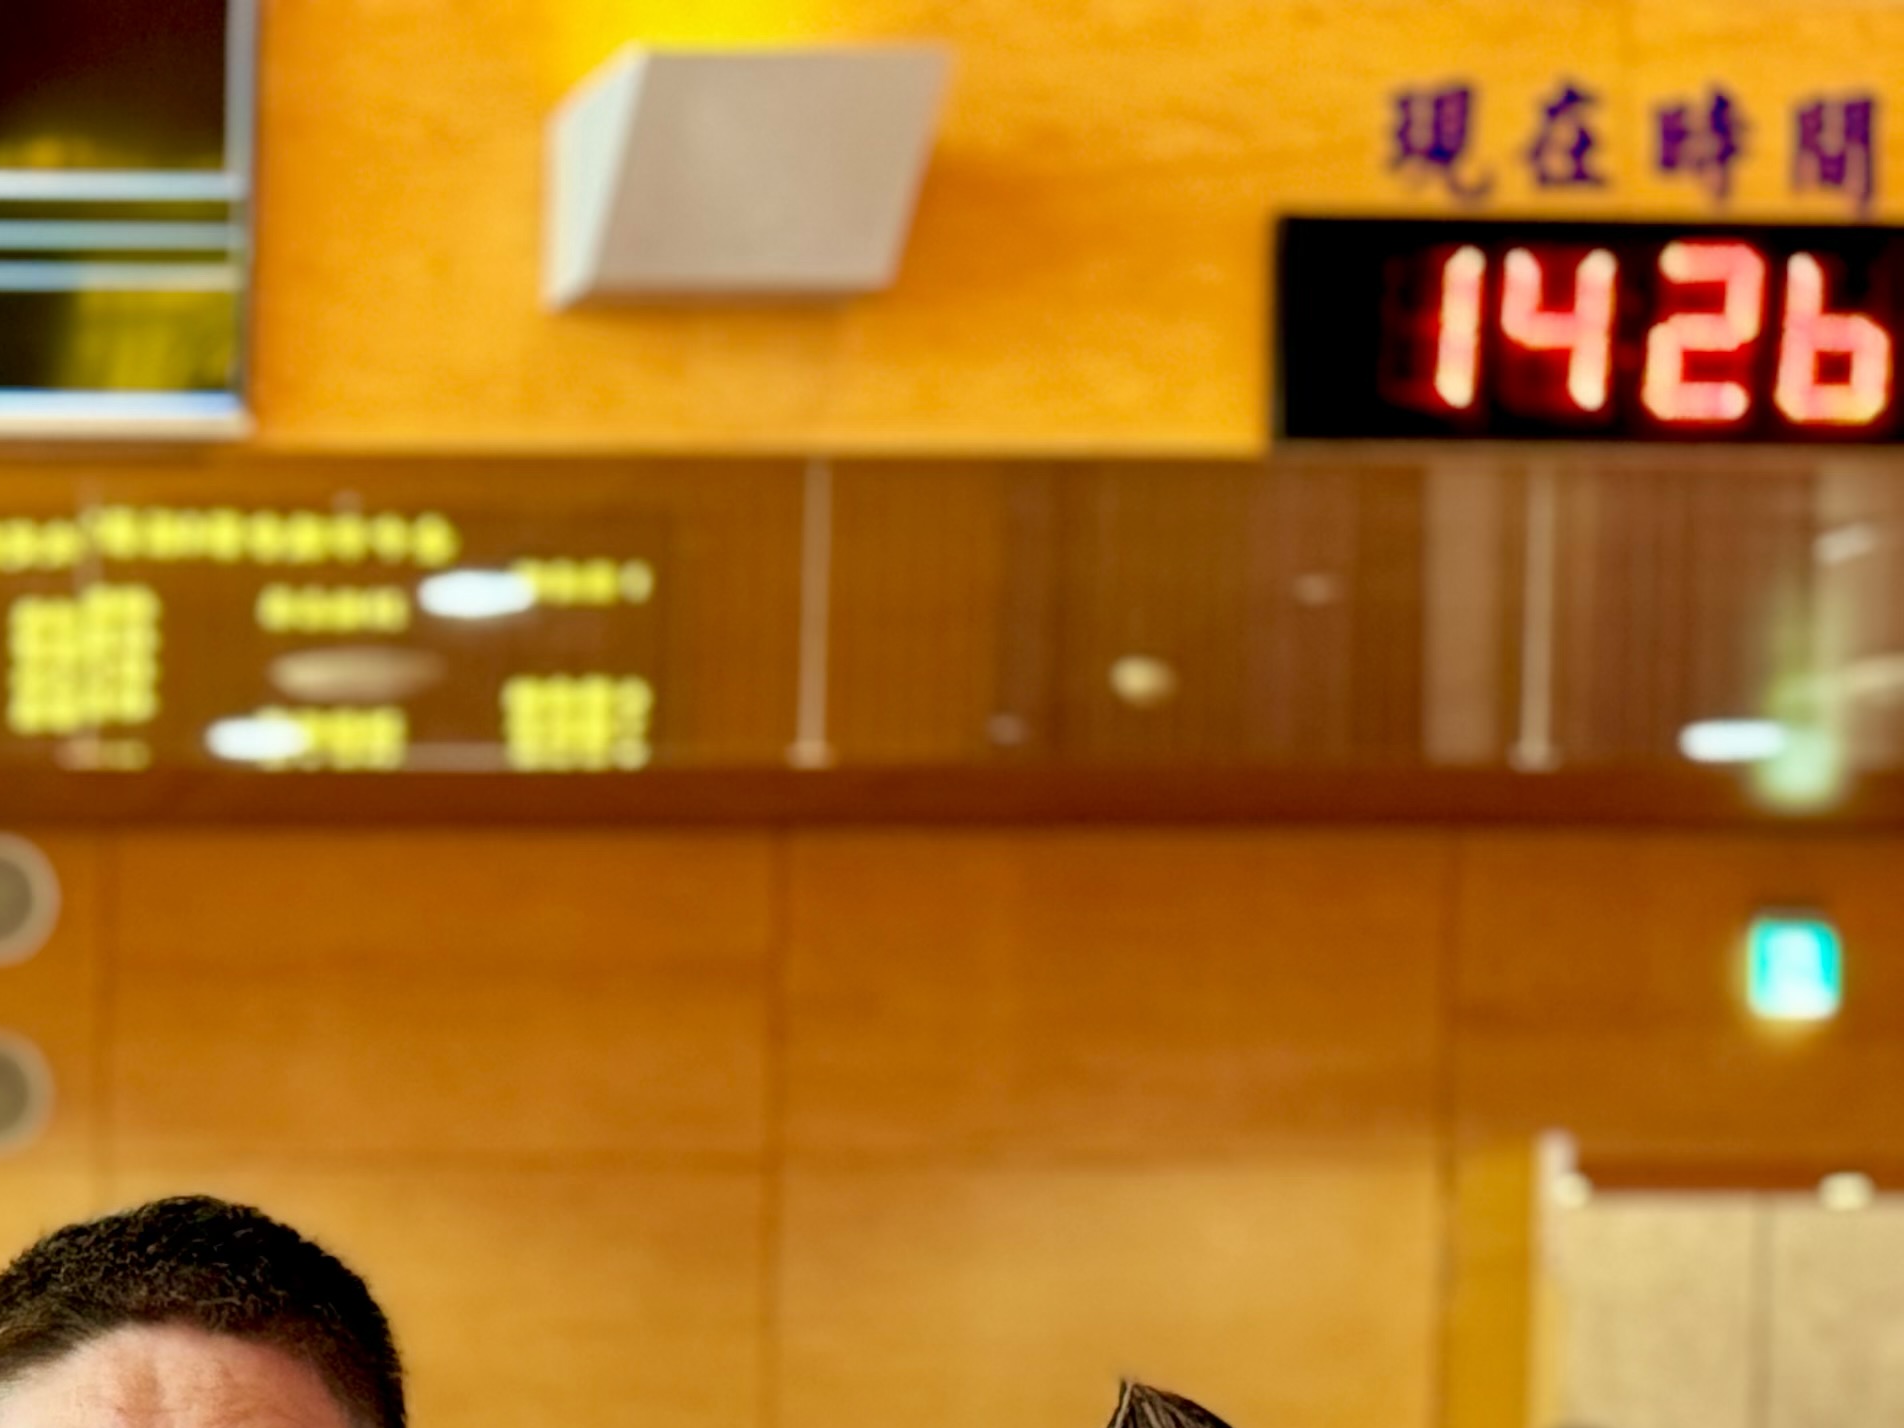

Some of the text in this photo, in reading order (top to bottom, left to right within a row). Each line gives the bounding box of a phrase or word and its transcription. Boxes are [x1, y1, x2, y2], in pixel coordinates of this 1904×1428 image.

[1391, 82, 1879, 210] 現在時間
[1434, 241, 1890, 424] 1426
